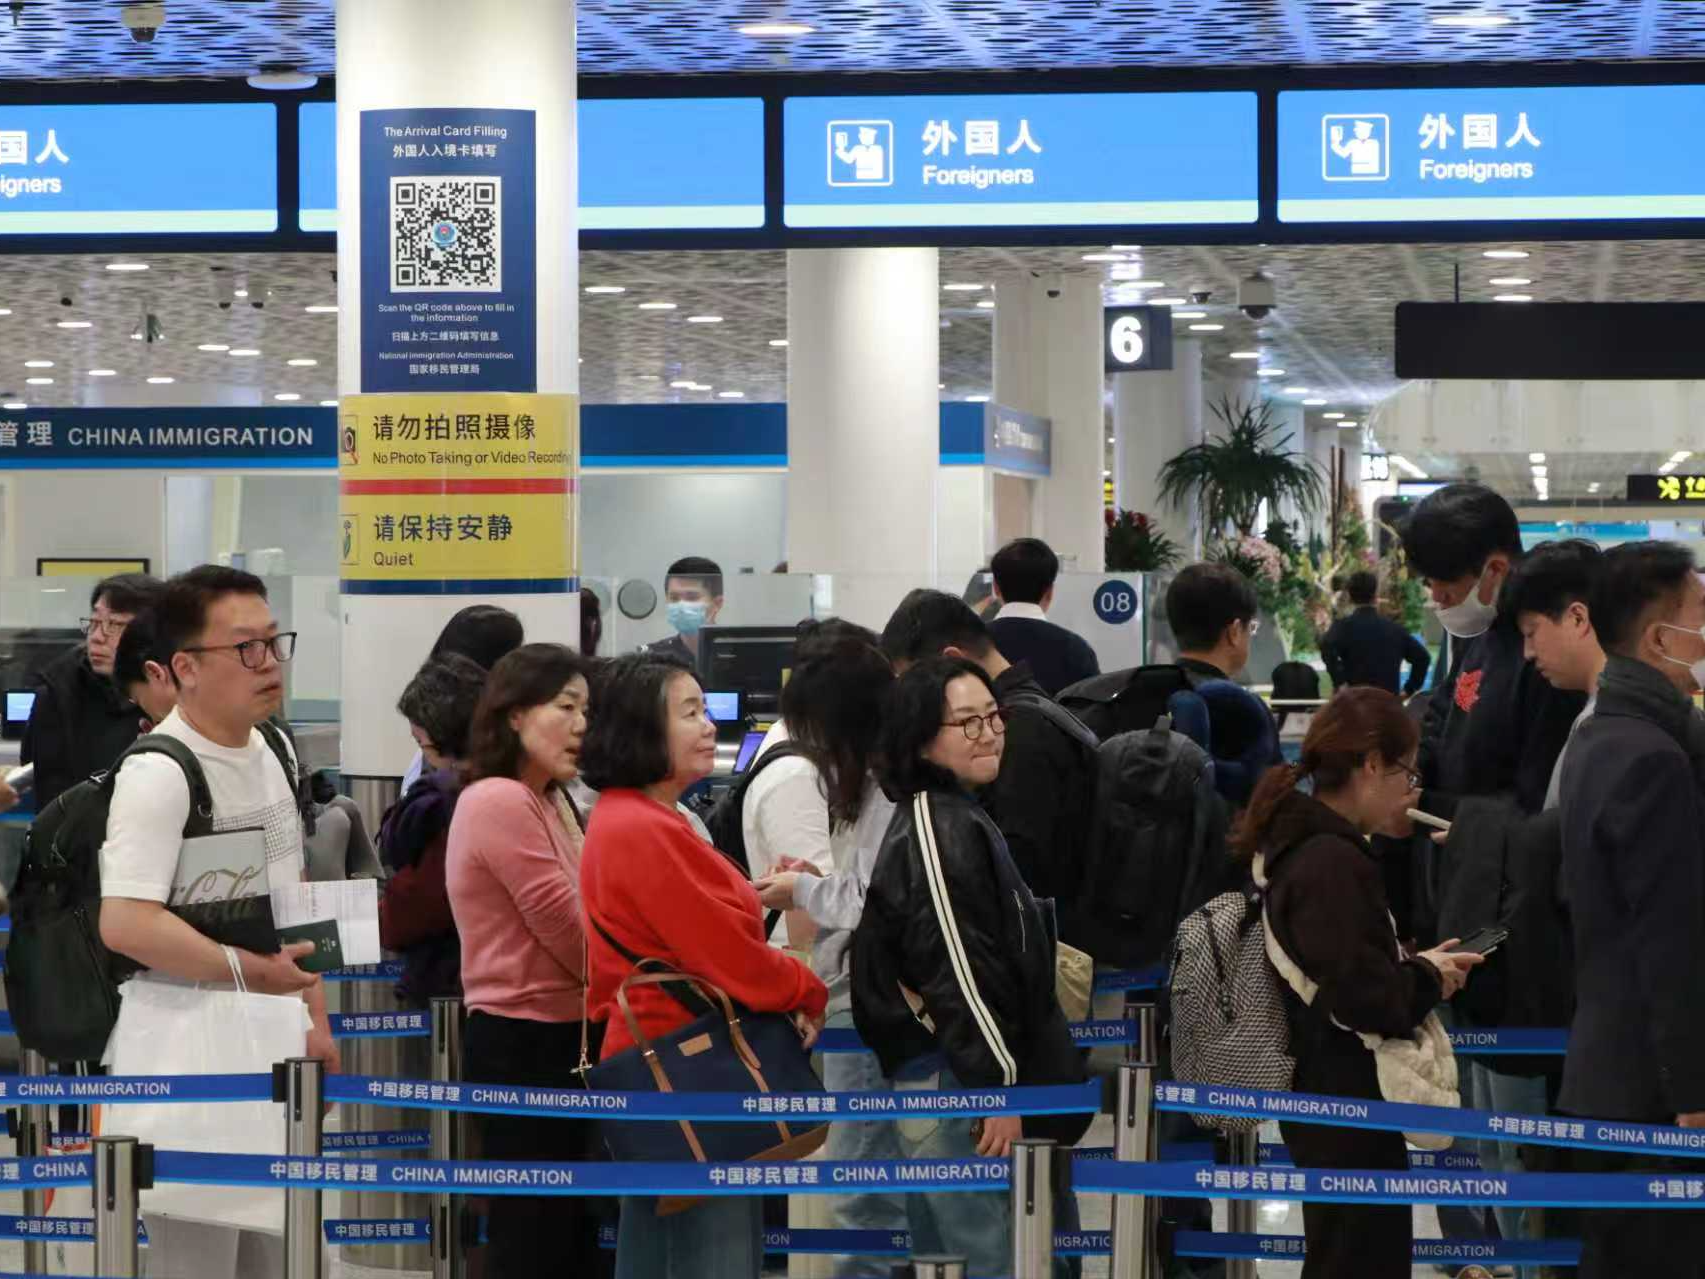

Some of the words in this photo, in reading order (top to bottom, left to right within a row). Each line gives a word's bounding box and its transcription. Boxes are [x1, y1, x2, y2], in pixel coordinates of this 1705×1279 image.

[384, 127, 403, 137] The
[404, 126, 440, 136] Arrival
[443, 125, 471, 136] Card
[474, 125, 507, 139] Filling
[921, 119, 1042, 156] 外国人
[1418, 112, 1541, 149] 外国人
[393, 143, 497, 157] 外国人入境卡填写
[922, 165, 1034, 189] Foreigners
[1420, 159, 1533, 183] Foreigners
[378, 304, 398, 312] Scan
[399, 304, 412, 312] the
[414, 303, 428, 312] QR
[430, 303, 453, 312] code
[455, 303, 482, 312] above
[485, 303, 493, 312] to
[495, 303, 505, 312] fill
[506, 303, 514, 312] in
[410, 314, 424, 322] the
[426, 314, 479, 322] information
[1110, 316, 1143, 363] 6
[379, 352, 408, 360] National
[457, 352, 514, 360] Administration
[409, 364, 480, 375] 国家移民管理局
[68, 427, 144, 446] CHINA
[149, 426, 314, 446] IMMIGRATION
[373, 413, 536, 441] 请勿拍照摄像
[373, 452, 388, 464] No
[390, 452, 426, 464] Photo
[431, 451, 472, 467] Taking
[475, 454, 488, 464] or
[491, 451, 526, 464] Video
[374, 514, 514, 541] 请保持安静
[374, 552, 414, 566] Quiet
[1101, 592, 1131, 612] 08
[342, 1015, 423, 1031] 中国移民管理
[18, 1083, 65, 1096] CHINA
[70, 1082, 170, 1096] IMMIGRATION
[368, 1080, 460, 1102] 中国移民管理
[472, 1089, 519, 1105] CHINA
[525, 1092, 628, 1109] IMMIGRATION
[743, 1096, 837, 1113] 中国移民管理
[849, 1096, 897, 1110] CHINA
[902, 1094, 1006, 1110] IMMIGRATION
[1208, 1091, 1257, 1109] CHINA
[1262, 1097, 1368, 1119] IMMIGRATION
[1488, 1116, 1585, 1140] 中国移民管理
[1597, 1126, 1647, 1145] CHINA
[0, 1163, 19, 1180] 理
[33, 1162, 87, 1178] CHINA
[270, 1161, 378, 1182] 中国移民管理
[391, 1167, 447, 1183] CHINA
[453, 1168, 573, 1185] IMMIGRATION
[708, 1166, 819, 1185] 中国移民管理
[832, 1167, 889, 1182] CHINA
[1195, 1169, 1306, 1192] 中国移民管理
[1320, 1176, 1378, 1192] CHINA
[1384, 1179, 1508, 1196] IMMIGRATION
[335, 1222, 416, 1238] 中国移民管理
